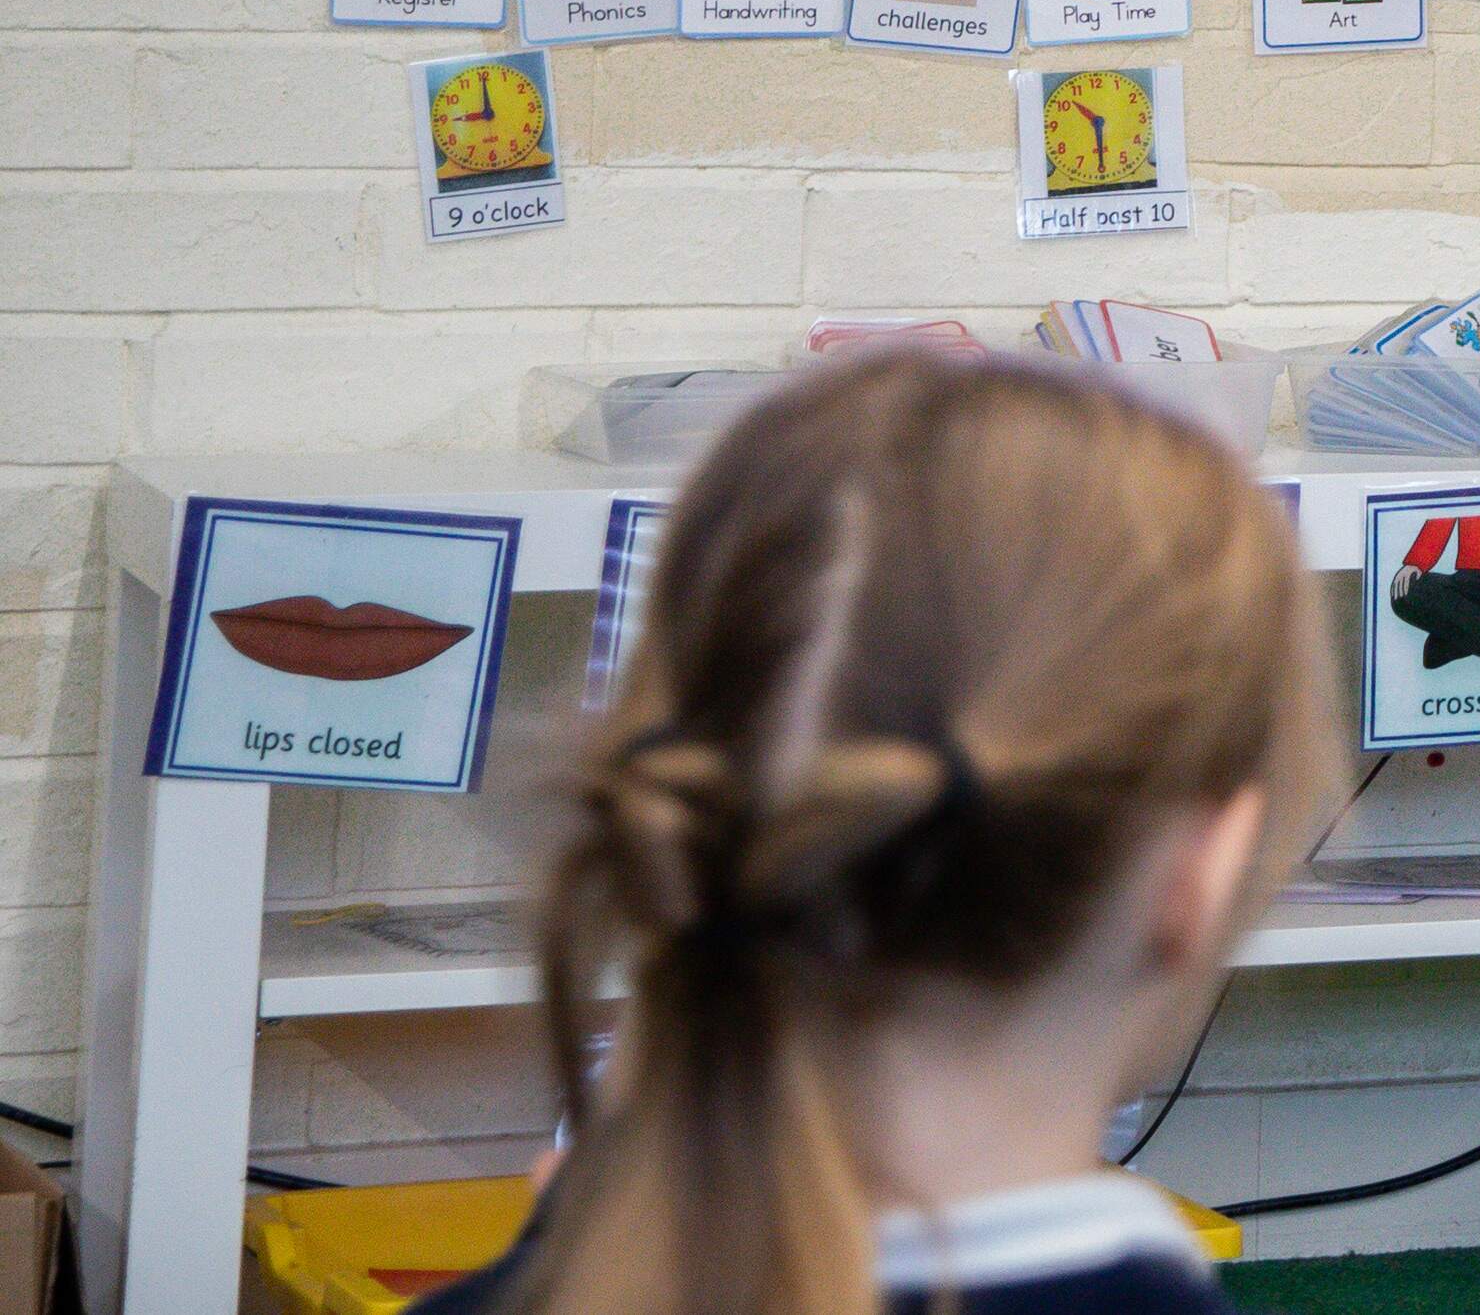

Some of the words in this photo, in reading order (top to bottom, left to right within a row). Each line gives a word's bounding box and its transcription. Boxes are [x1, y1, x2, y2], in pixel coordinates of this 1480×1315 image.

[567, 1, 647, 24] Phonics
[703, 0, 818, 28] Handwriting
[877, 8, 987, 39] challenges
[1063, 5, 1101, 32] Play
[1111, 1, 1157, 21] Time
[1329, 11, 1357, 28] Art
[448, 206, 464, 228] 9
[472, 196, 549, 225] o'clock
[1041, 206, 1088, 229] Half
[1097, 206, 1142, 229] past
[1151, 202, 1175, 223] 10
[244, 721, 295, 761] lips
[307, 727, 403, 760] closed
